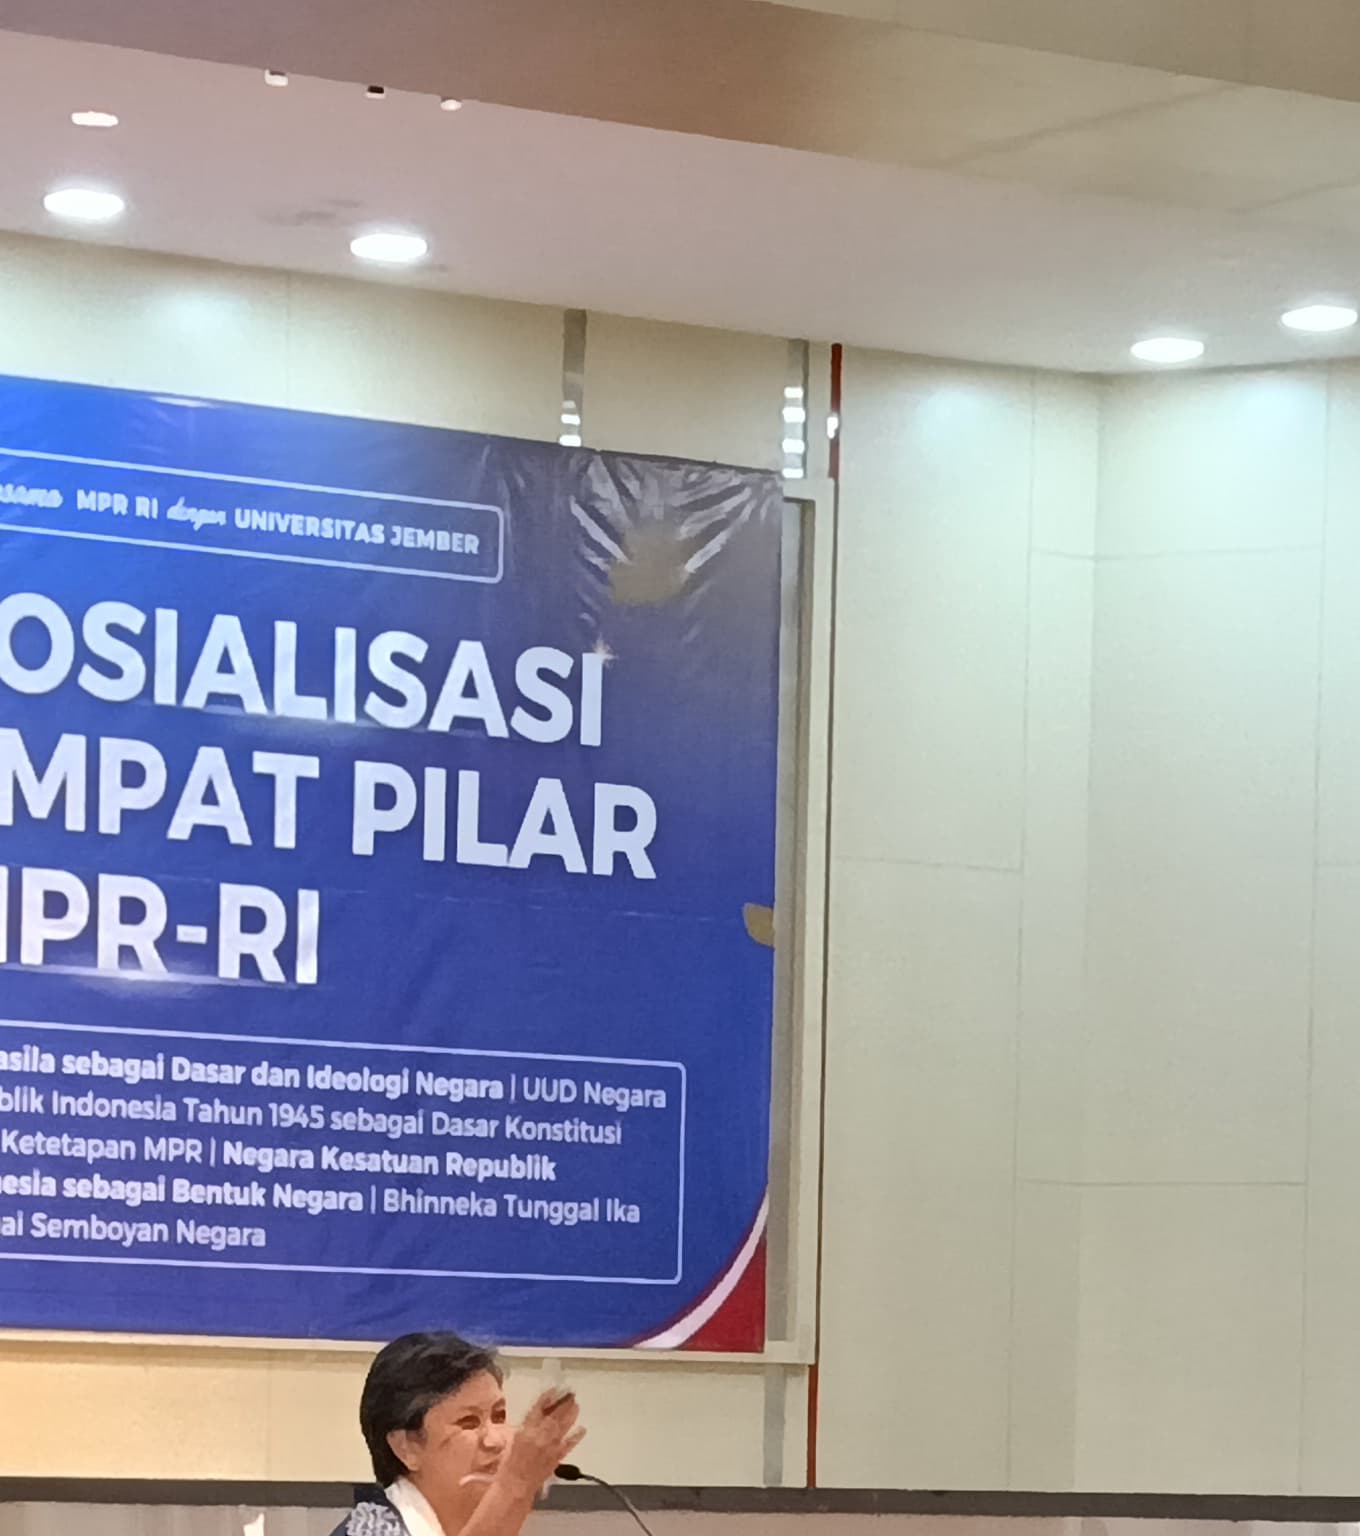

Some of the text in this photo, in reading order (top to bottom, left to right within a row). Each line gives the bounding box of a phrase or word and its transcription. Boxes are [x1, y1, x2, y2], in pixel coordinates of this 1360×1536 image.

[76, 489, 128, 516] MPR
[135, 495, 158, 519] RI
[234, 508, 385, 544] UNIVERSITAS
[390, 525, 479, 554] JEMBER
[351, 760, 657, 879] PILAR
[61, 1050, 164, 1084] sebagai
[170, 1056, 246, 1082] Dasar
[250, 1061, 300, 1088] dan
[306, 1064, 409, 1099] Ideologi
[415, 1070, 504, 1102] Negara
[522, 1077, 577, 1101] UUD
[583, 1082, 667, 1112] Negara
[51, 1089, 177, 1122] Indonesia
[183, 1096, 263, 1126] Tahun
[269, 1102, 325, 1129] 1945
[329, 1107, 424, 1139] sebagai
[431, 1110, 499, 1138] Dasar
[505, 1115, 623, 1145] Konstitusi
[1, 1128, 136, 1165] Ketetapan
[144, 1136, 203, 1164] MPR
[223, 1141, 314, 1173] Negara
[321, 1146, 438, 1175] Kesatuan
[445, 1151, 557, 1183] Republik
[62, 1173, 166, 1207] sebagai
[172, 1178, 266, 1207] Bentuk
[273, 1183, 363, 1215] Negara
[383, 1187, 498, 1214] Bhinneka
[503, 1193, 600, 1226] Tunggal
[605, 1198, 641, 1223] Ika
[29, 1211, 169, 1247] Semboyan
[176, 1218, 267, 1250] Negara
